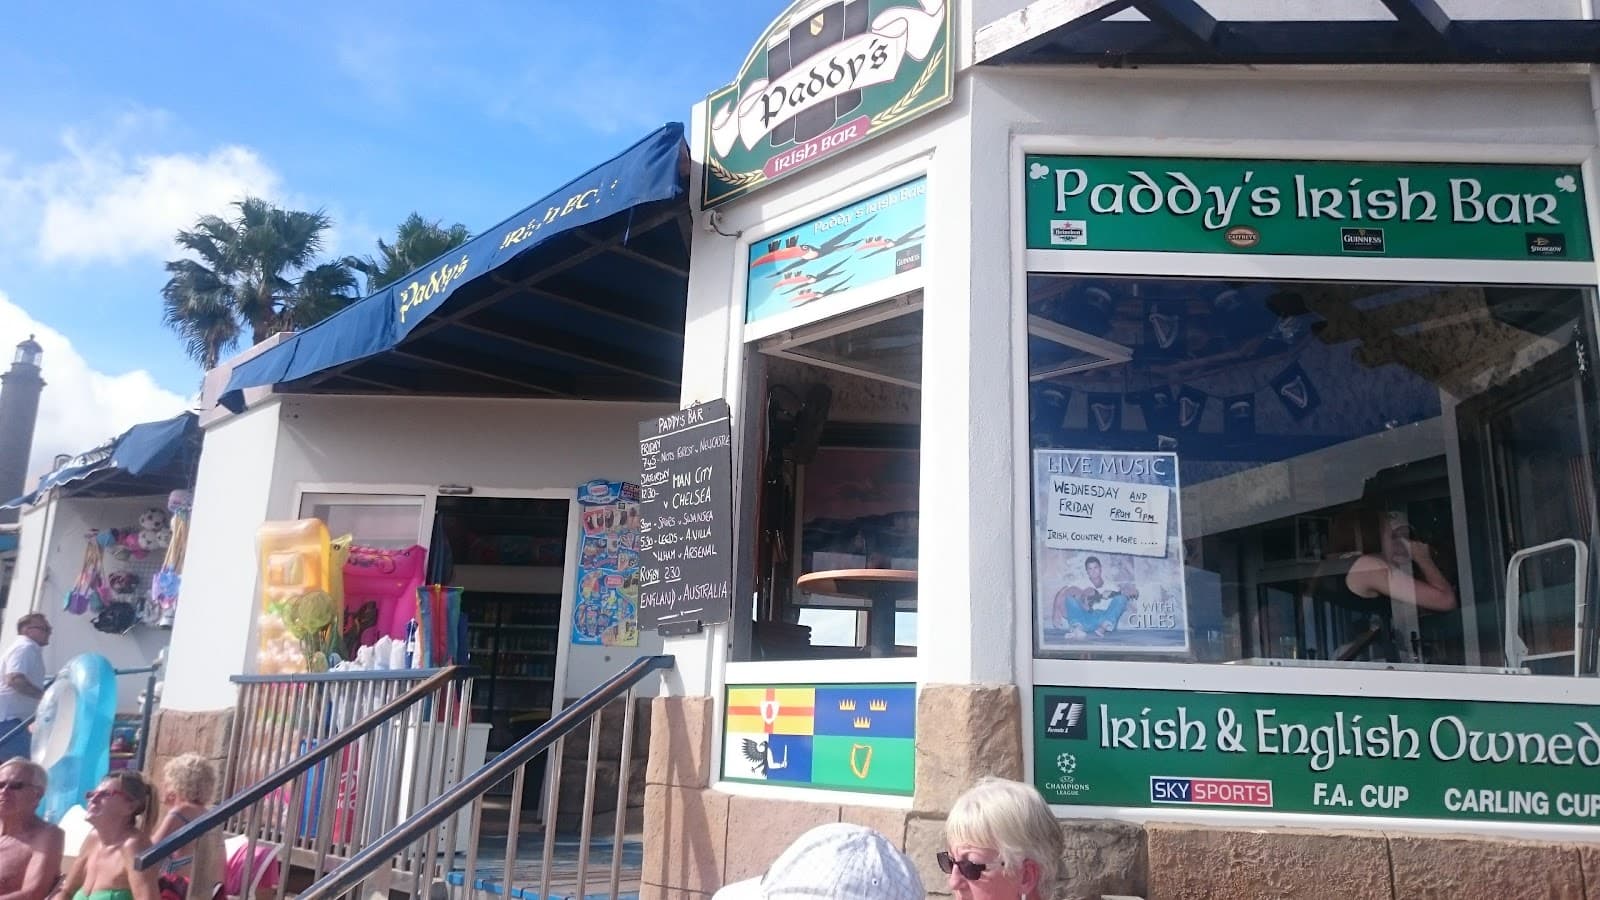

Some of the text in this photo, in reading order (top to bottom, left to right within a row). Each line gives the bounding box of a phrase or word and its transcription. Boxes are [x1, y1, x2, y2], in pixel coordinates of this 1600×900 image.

[759, 38, 889, 129] Paddy's
[1054, 168, 1560, 230] Paddy's Irish Bar
[1343, 234, 1382, 244] GUINNESS
[687, 408, 703, 425] BAR
[672, 465, 713, 489] MAN CITY
[1048, 456, 1166, 477] LIVE MUSIC
[672, 486, 711, 510] CHELSEA
[1054, 480, 1148, 502] WEDNESDAY AND
[1059, 498, 1095, 516] FRIDAY
[1109, 507, 1131, 520] FROM
[684, 543, 718, 560] ARSENAL
[683, 580, 727, 602] AUSTRALIA
[1049, 702, 1084, 727] F1
[1099, 703, 1600, 771] Irish & English Owned
[1045, 782, 1090, 791] CHAMPIONS
[1154, 782, 1268, 803] SKY SPORTS
[1313, 782, 1409, 809] F.A. CUP
[1444, 788, 1549, 815] CARLING
